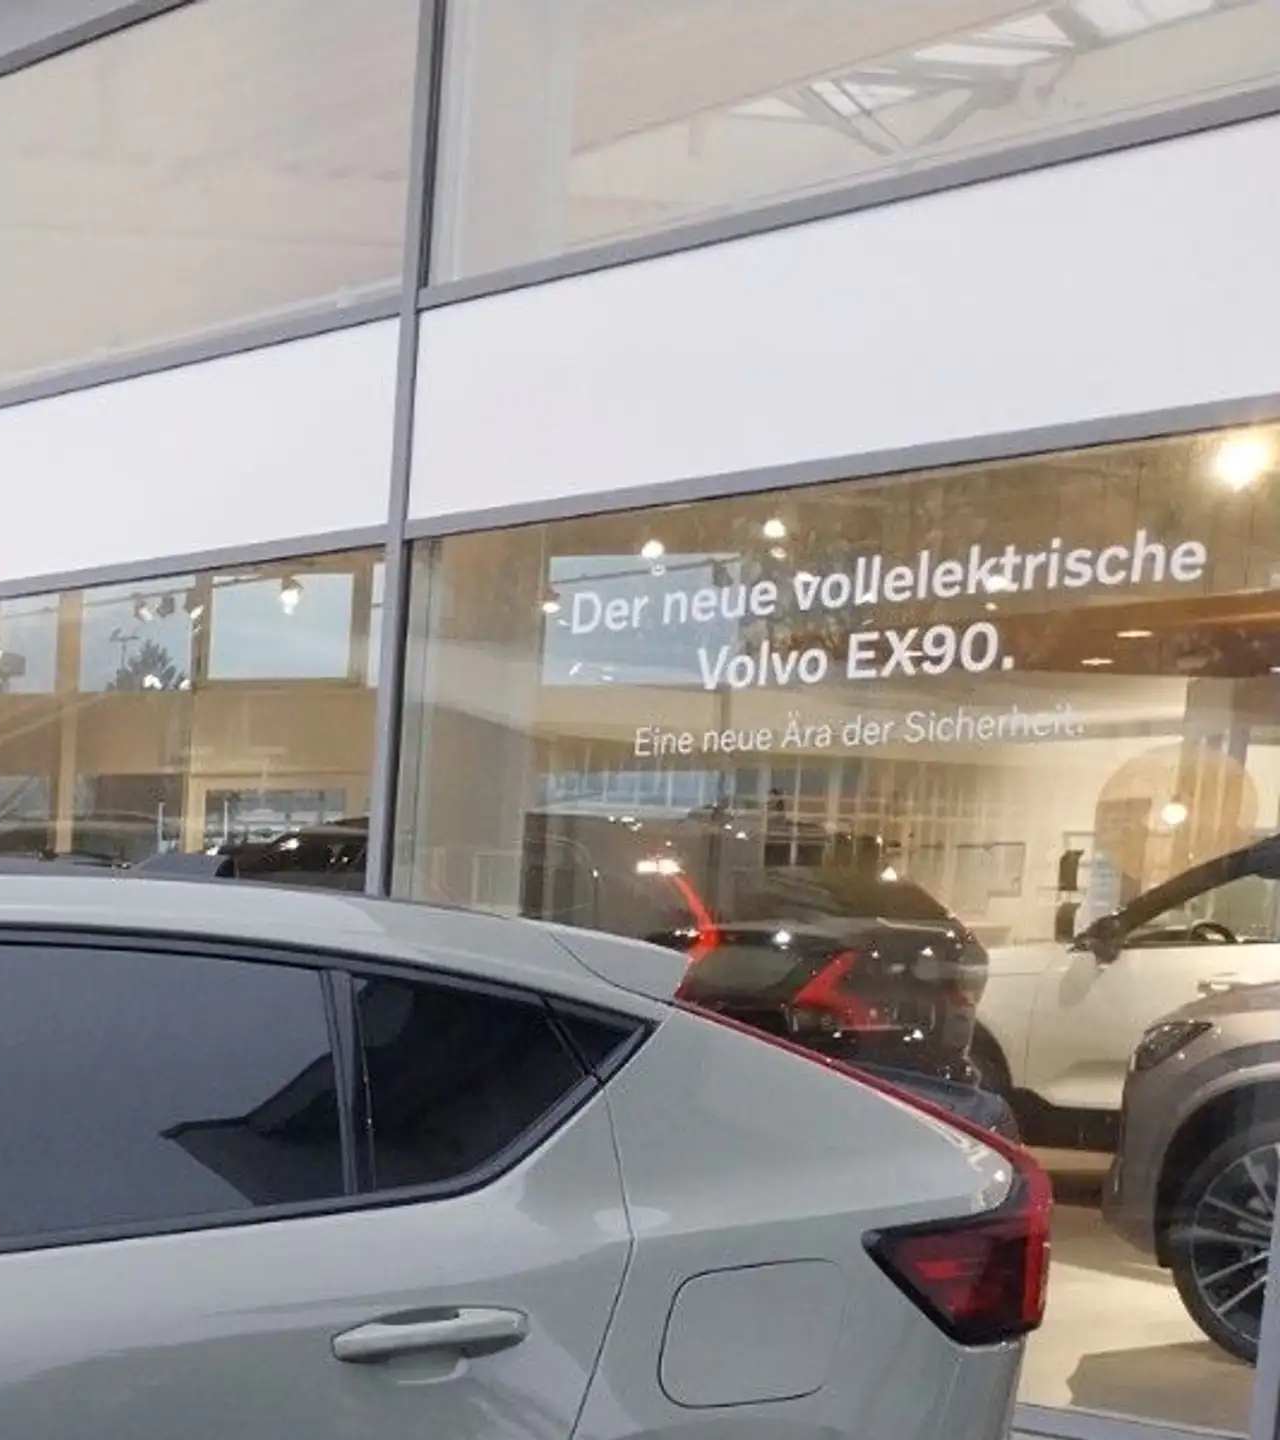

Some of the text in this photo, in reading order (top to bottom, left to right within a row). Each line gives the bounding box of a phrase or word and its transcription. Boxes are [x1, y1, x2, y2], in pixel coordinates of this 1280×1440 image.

[571, 528, 1208, 635] Der neue vollelektrische
[697, 620, 1015, 691] Volvo EX90.
[633, 703, 1086, 758] Eine neue Ära der Sicherheit.
